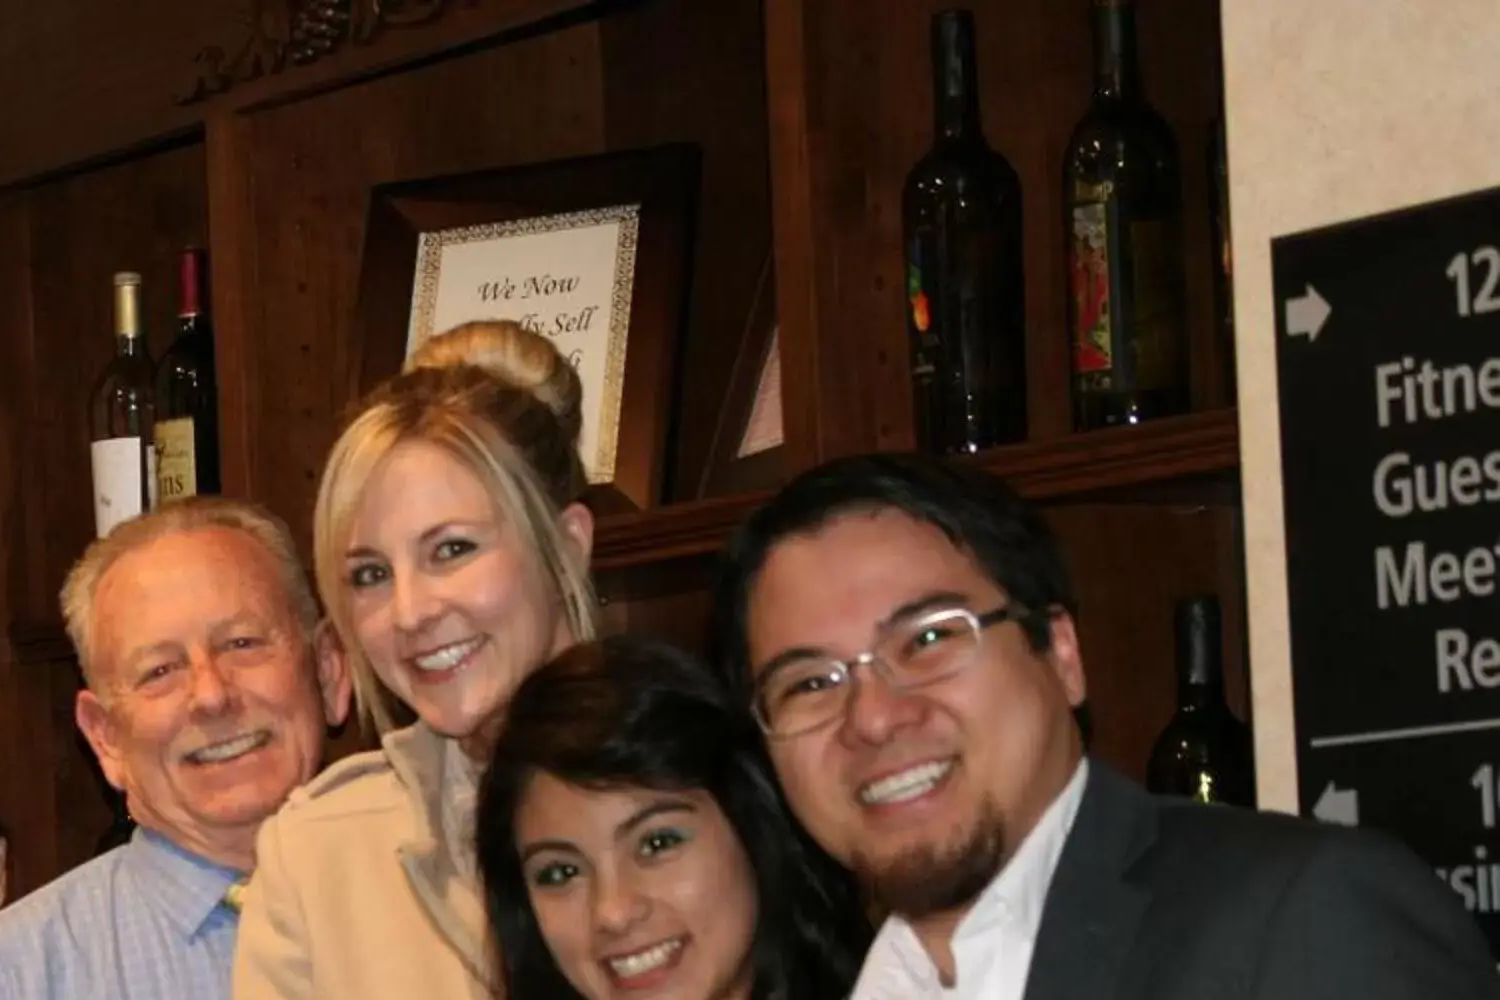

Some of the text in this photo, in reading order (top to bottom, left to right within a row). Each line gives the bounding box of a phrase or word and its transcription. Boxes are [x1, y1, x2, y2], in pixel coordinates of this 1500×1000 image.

[477, 274, 580, 301] We Now
[548, 306, 599, 336] Sell
[1374, 541, 1500, 609] Mee
[1468, 763, 1500, 829] 1
